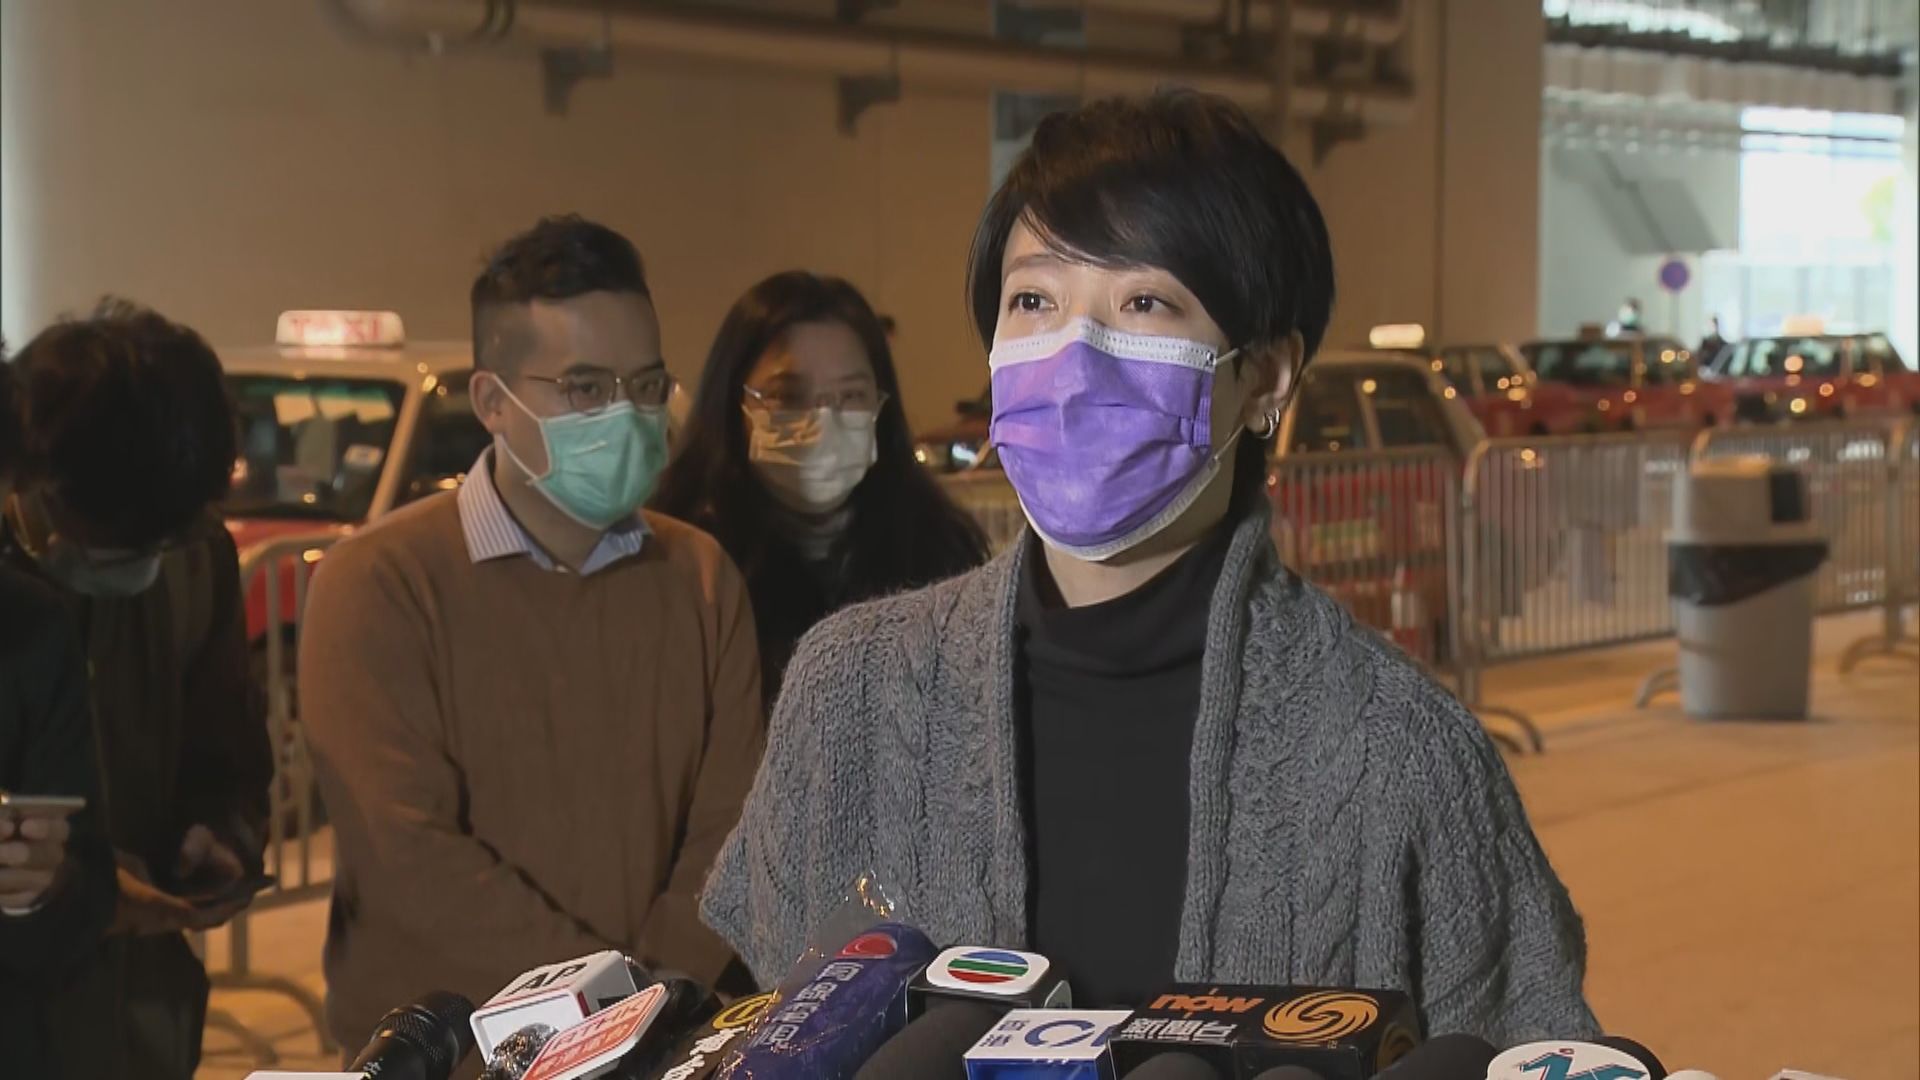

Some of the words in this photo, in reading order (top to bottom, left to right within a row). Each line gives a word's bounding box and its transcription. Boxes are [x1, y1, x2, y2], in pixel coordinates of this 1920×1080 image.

[504, 962, 587, 996] AP
[1149, 991, 1265, 1014] now
[553, 1003, 642, 1050] RTHK
